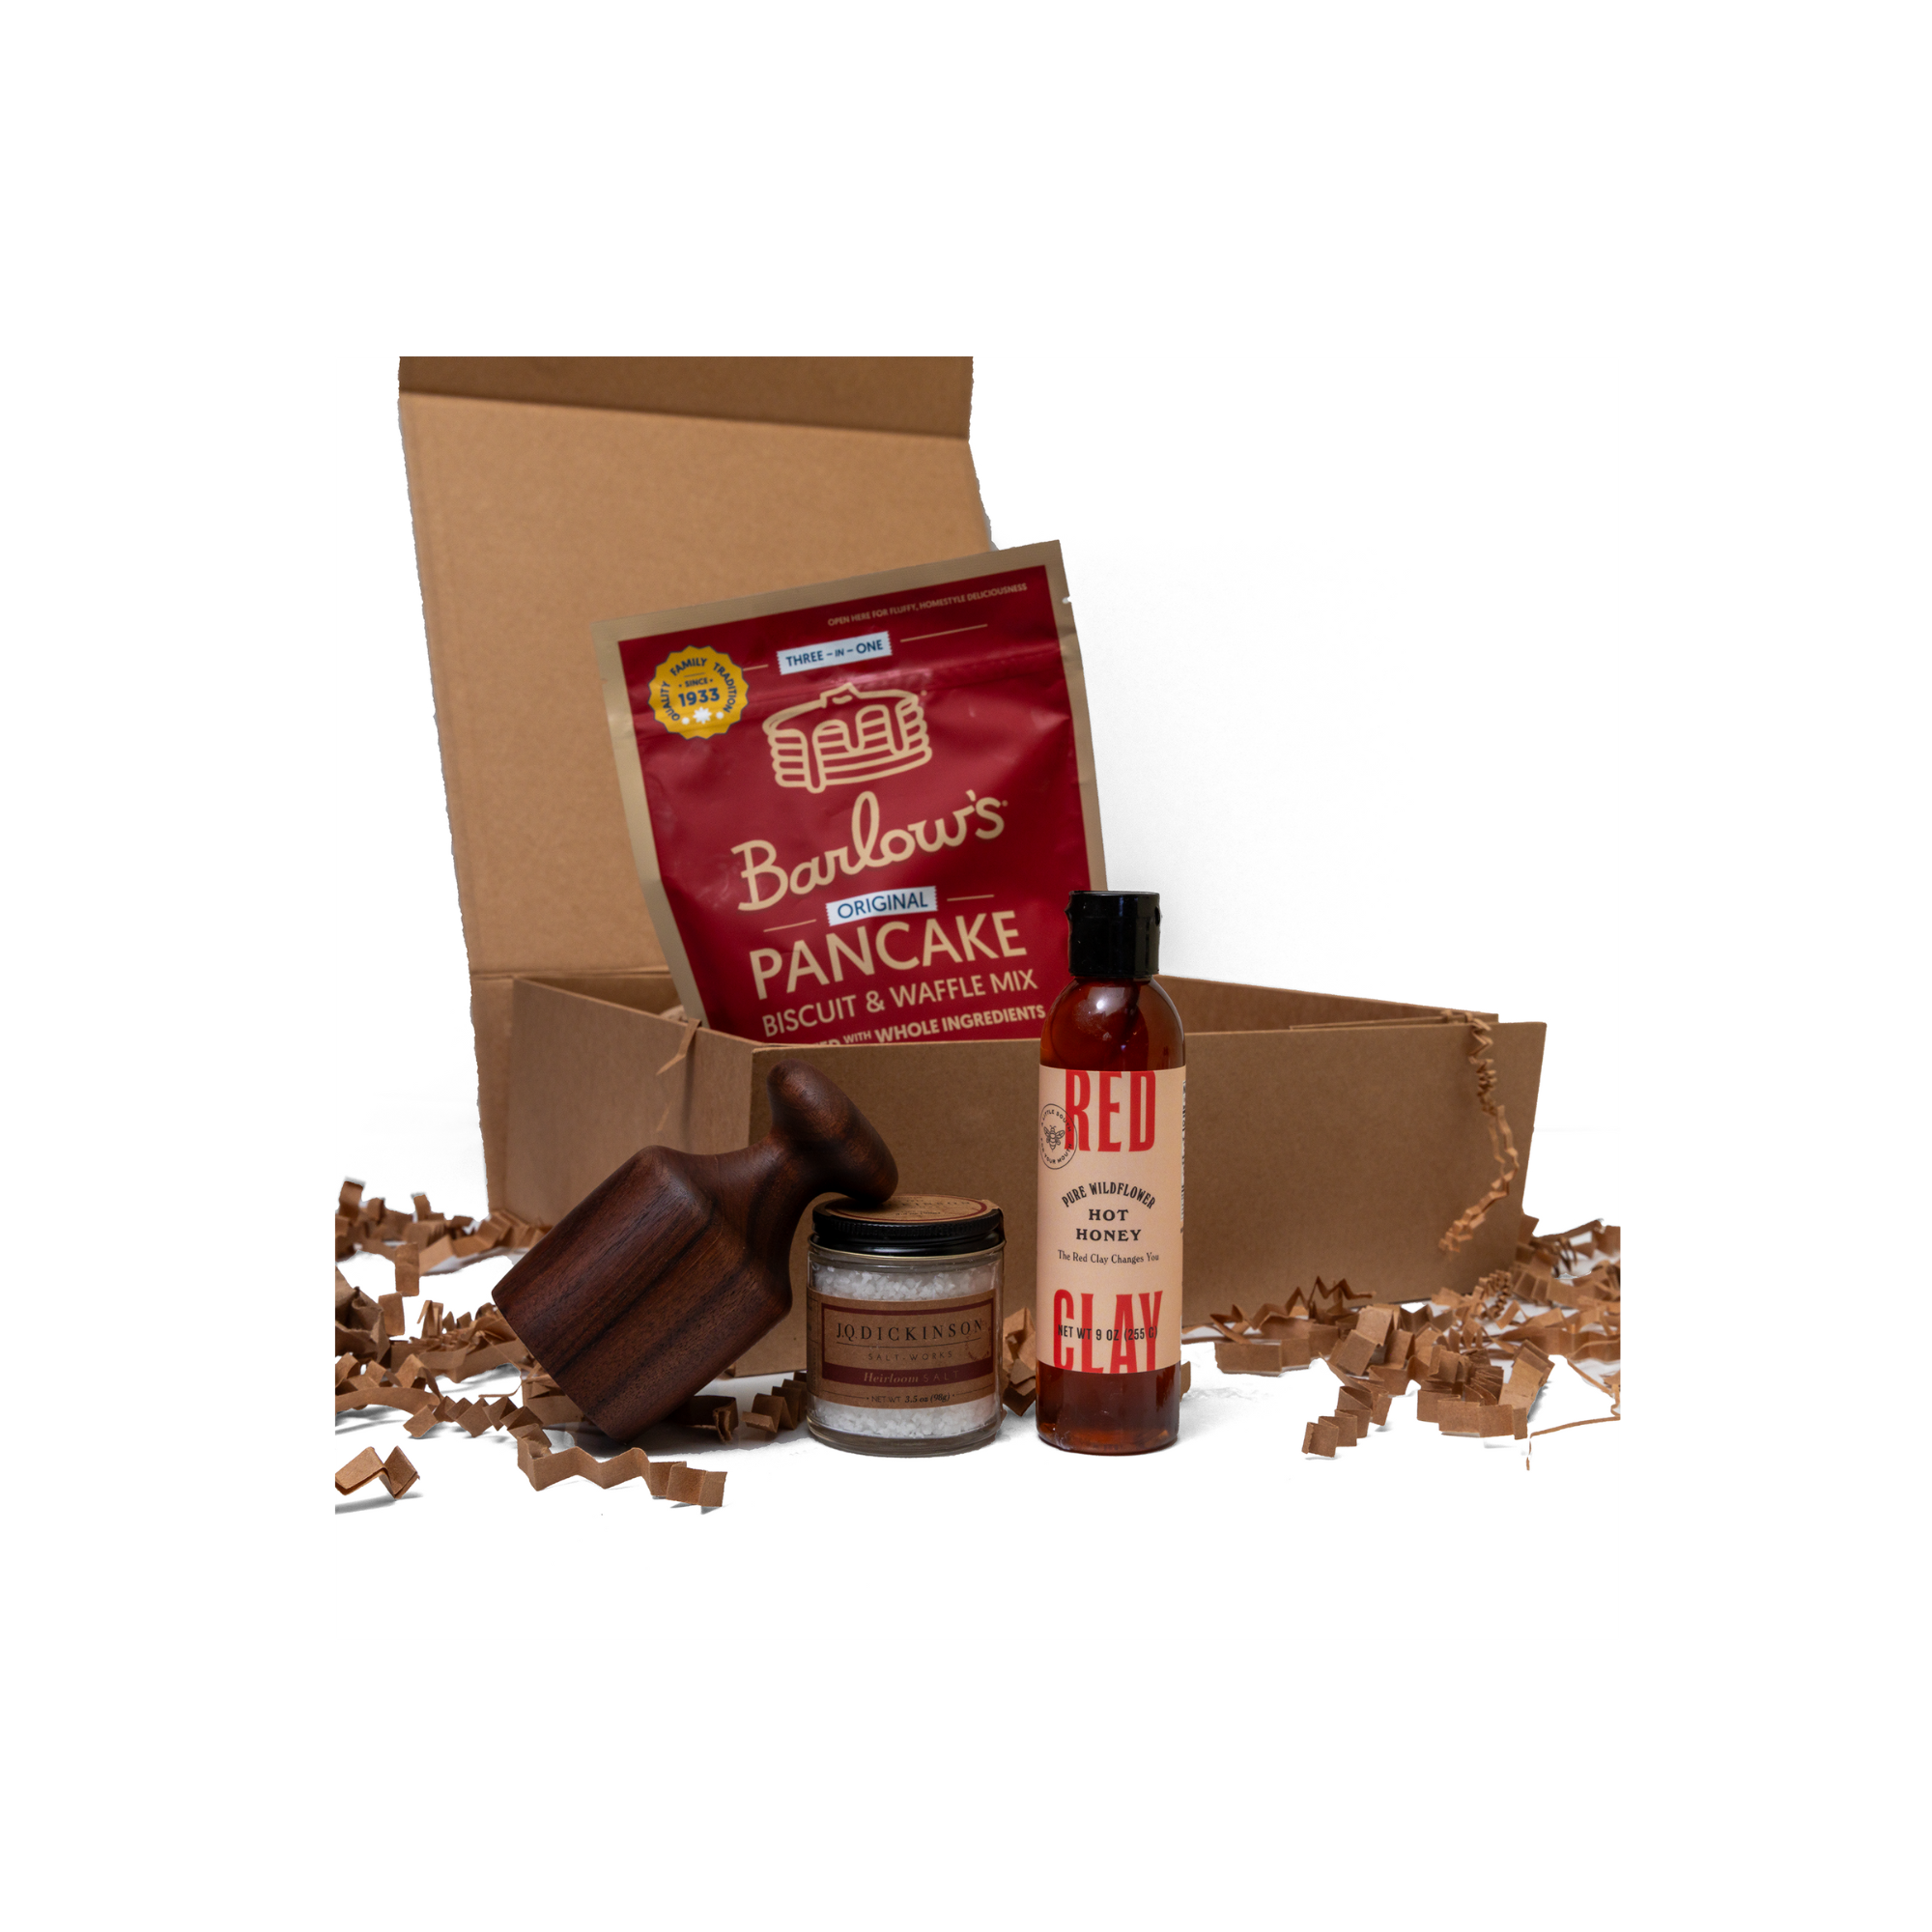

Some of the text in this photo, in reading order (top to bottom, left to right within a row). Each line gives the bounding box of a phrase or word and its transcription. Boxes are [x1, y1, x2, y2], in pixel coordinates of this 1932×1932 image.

[828, 582, 1028, 626] OPEN HERE FOR FLUFFY, HOMESTYLE DELICIOUSNESS
[785, 650, 824, 667] THREE
[856, 639, 883, 654] ONE
[660, 657, 737, 722] QUALITY FAMILY TRADITION
[684, 677, 708, 688] SINCE
[678, 687, 720, 707] 1933
[730, 789, 1006, 912] Barlow's
[837, 891, 929, 920] ORIGINAL
[749, 910, 1028, 1001] PANCAKE
[761, 969, 1038, 1037] BISCUIT & WAFFLE MIX
[843, 1005, 1046, 1045] WITH WHOLE INGREDIENTS
[1064, 1069, 1156, 1151] RED
[1057, 1144, 1072, 1163] MOUTH
[1061, 1181, 1156, 1209] PURE WILDFLOWER
[1089, 1209, 1129, 1221] HOT
[1076, 1228, 1142, 1242] HONEY
[1058, 1249, 1159, 1264] The Red Clay Changes You
[1053, 1289, 1163, 1374] CLAY
[1057, 1323, 1074, 1338] NET
[1076, 1327, 1092, 1340] WT
[1095, 1328, 1102, 1341] 9
[1106, 1329, 1120, 1341] OZ
[1123, 1327, 1145, 1342] (255
[864, 1370, 960, 1383] Heirloom SALT
[904, 1395, 918, 1404] 3.5
[930, 1393, 951, 1404] (98g)
